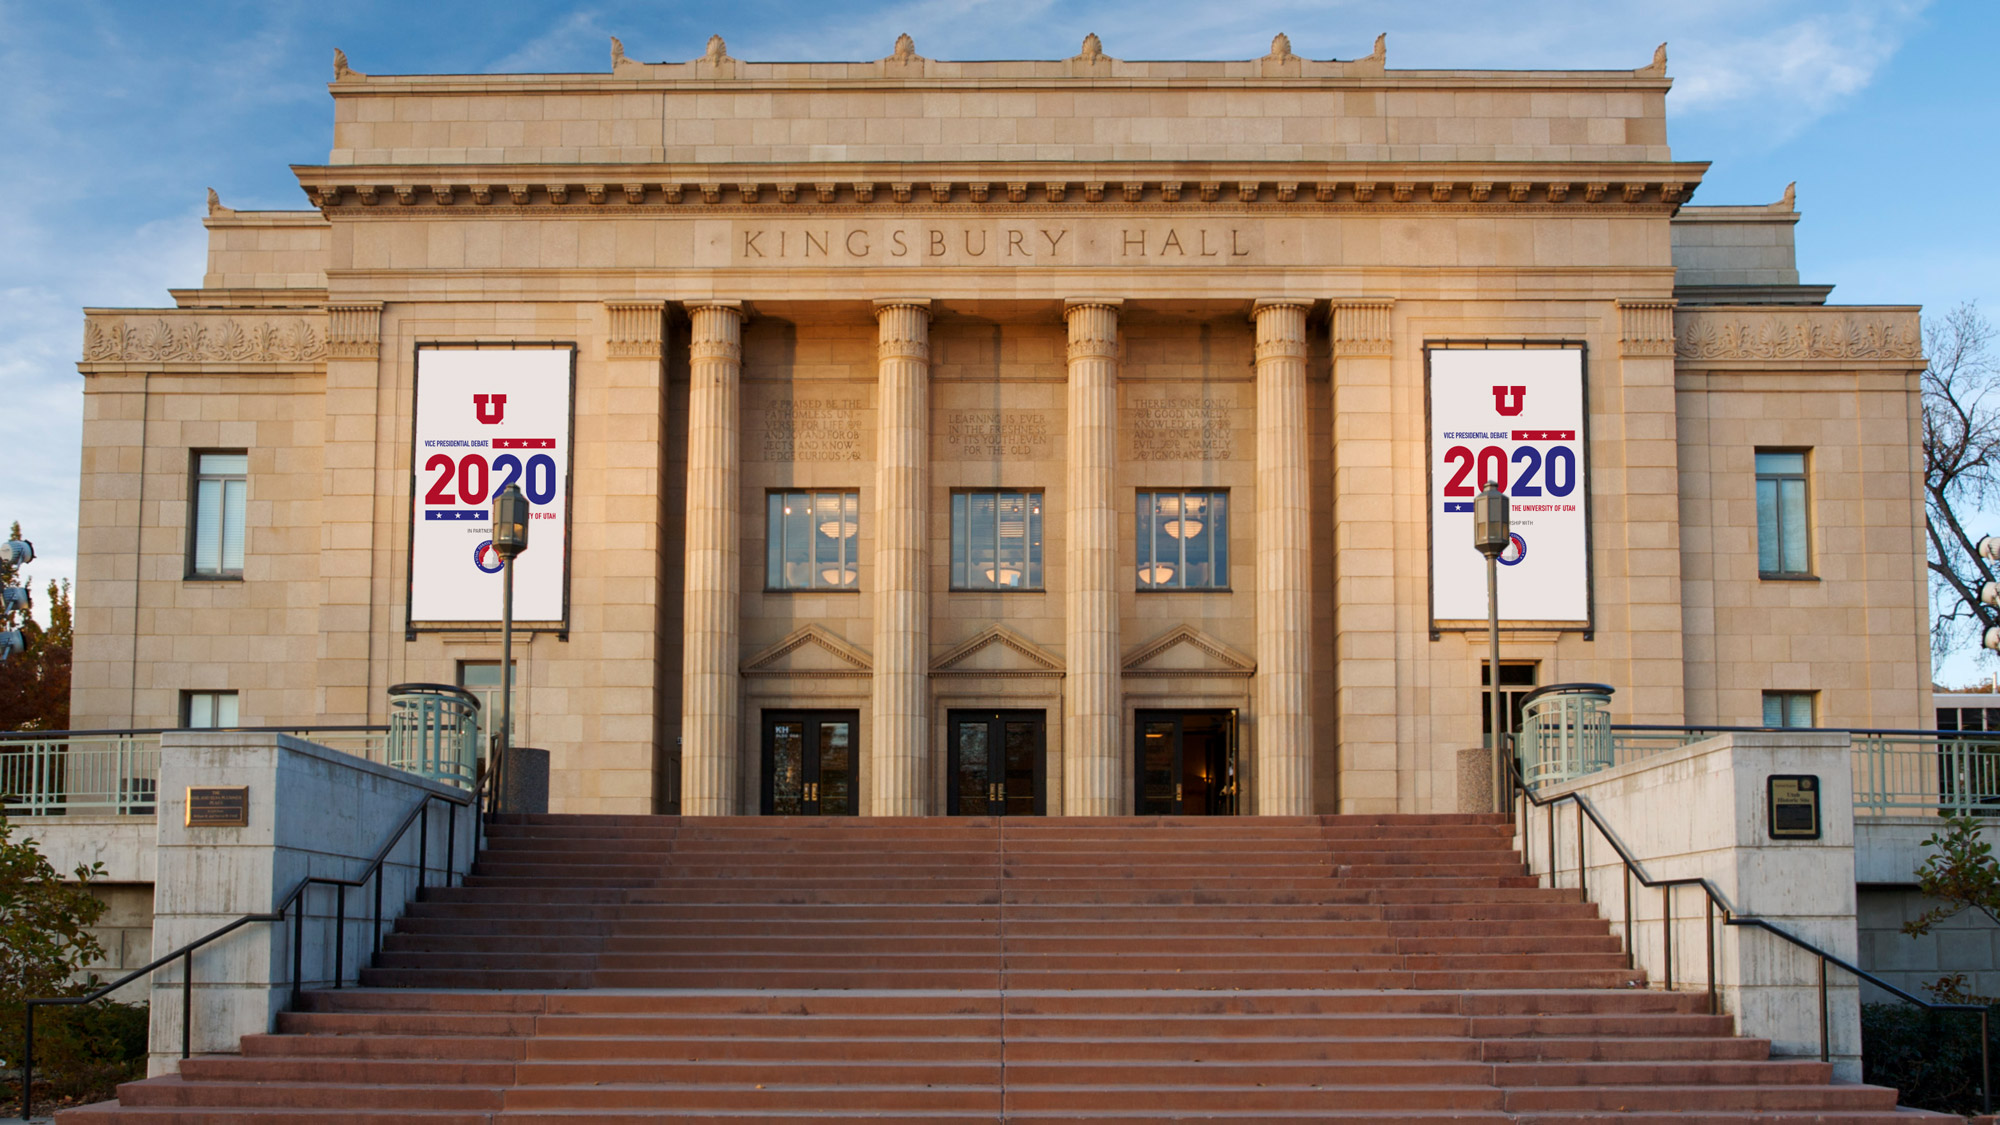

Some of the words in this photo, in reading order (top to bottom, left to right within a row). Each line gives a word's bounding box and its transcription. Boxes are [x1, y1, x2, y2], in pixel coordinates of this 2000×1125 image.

[743, 229, 1068, 257] KINGSBURY
[1121, 228, 1250, 256] HALL
[780, 400, 822, 409] PRAISED
[826, 400, 838, 409] BE
[842, 400, 862, 409] THE
[1133, 399, 1165, 408] THERE
[1168, 399, 1177, 408] IS
[1180, 399, 1200, 408] ONE
[1203, 399, 1231, 408] ONLY
[764, 410, 833, 419] FATHOMLESS
[948, 414, 1001, 424] LEARNING
[1006, 414, 1015, 423] IS
[1020, 414, 1046, 423] EVER
[764, 420, 797, 429] VERSE
[801, 420, 819, 430] FOR
[823, 420, 844, 430] LIFE
[948, 425, 959, 434] IN
[965, 425, 984, 434] THE
[989, 425, 1047, 434] FRESHNESS
[764, 431, 785, 440] AND
[786, 431, 803, 440] JOY
[805, 431, 825, 440] AND
[827, 430, 845, 440] FOR
[1134, 429, 1155, 438] AND
[1168, 429, 1190, 438] ONE
[1203, 429, 1231, 438] ONLY
[1443, 431, 1454, 439] VICE
[1455, 431, 1489, 439] PRESIDENTIAL
[1490, 431, 1508, 439] DEBATE
[949, 435, 960, 444] OF
[964, 435, 980, 444] ITS
[1020, 435, 1047, 444] EVEN
[764, 441, 794, 450] JECTS
[798, 441, 819, 450] AND
[1188, 440, 1231, 449] NAMELY
[964, 446, 982, 455] FOR
[987, 446, 1006, 455] THE
[1011, 446, 1031, 455] OLD
[764, 451, 796, 460] LEDGE
[1444, 445, 1576, 497] 2020
[425, 453, 556, 505] 2020
[1511, 504, 1521, 512] THE
[1522, 504, 1553, 512] UNIVERSITY
[1554, 504, 1561, 512] OF
[1562, 504, 1576, 512] UTAH
